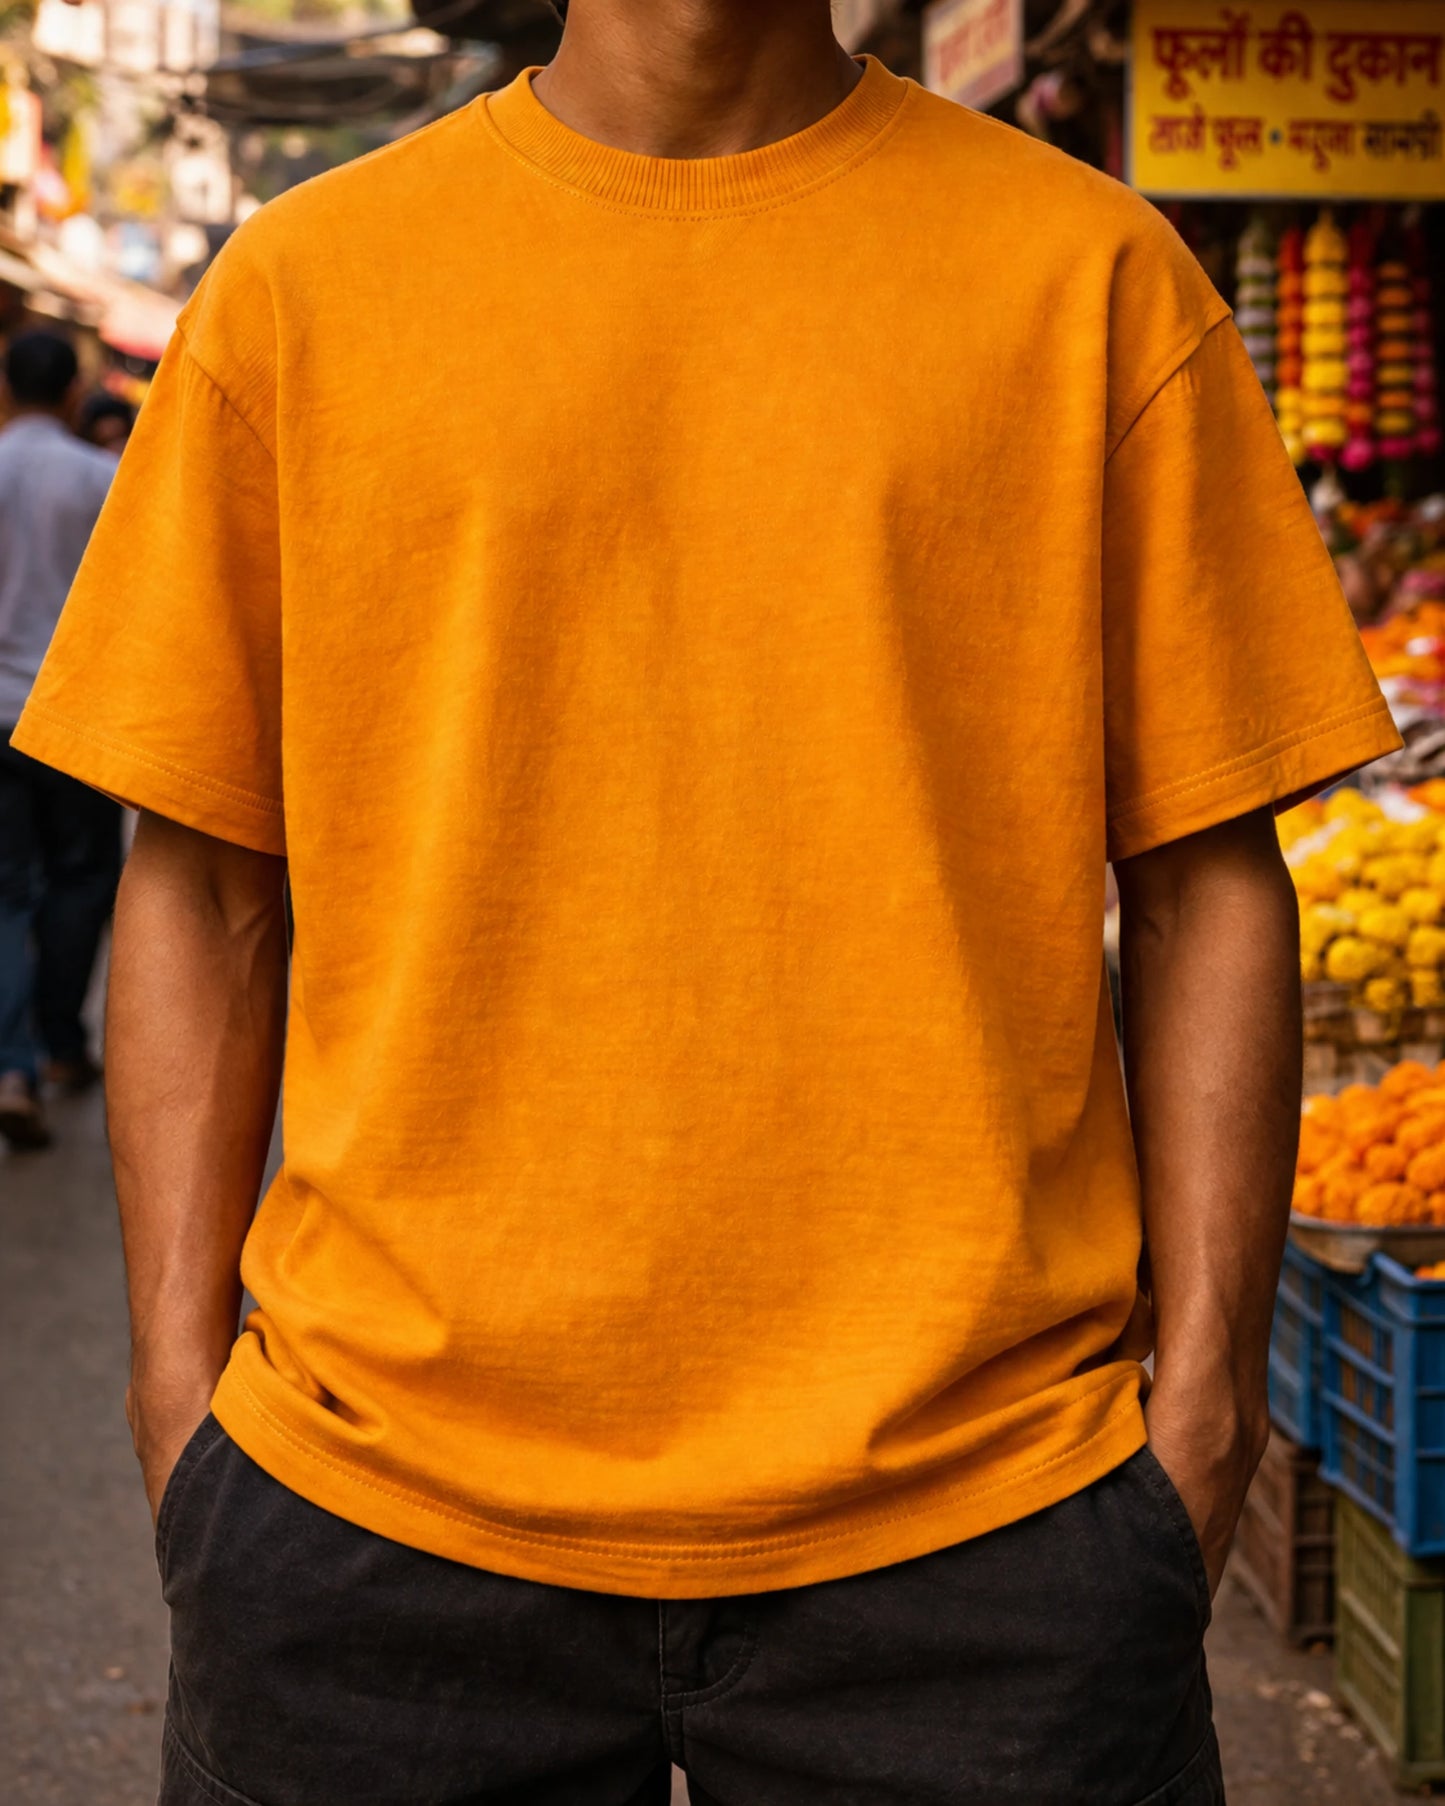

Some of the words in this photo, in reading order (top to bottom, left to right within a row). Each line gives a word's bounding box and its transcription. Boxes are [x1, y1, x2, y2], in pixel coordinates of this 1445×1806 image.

[1153, 8, 1248, 101] फूलों
[1258, 11, 1313, 82] की
[1324, 31, 1443, 104] दुकान
